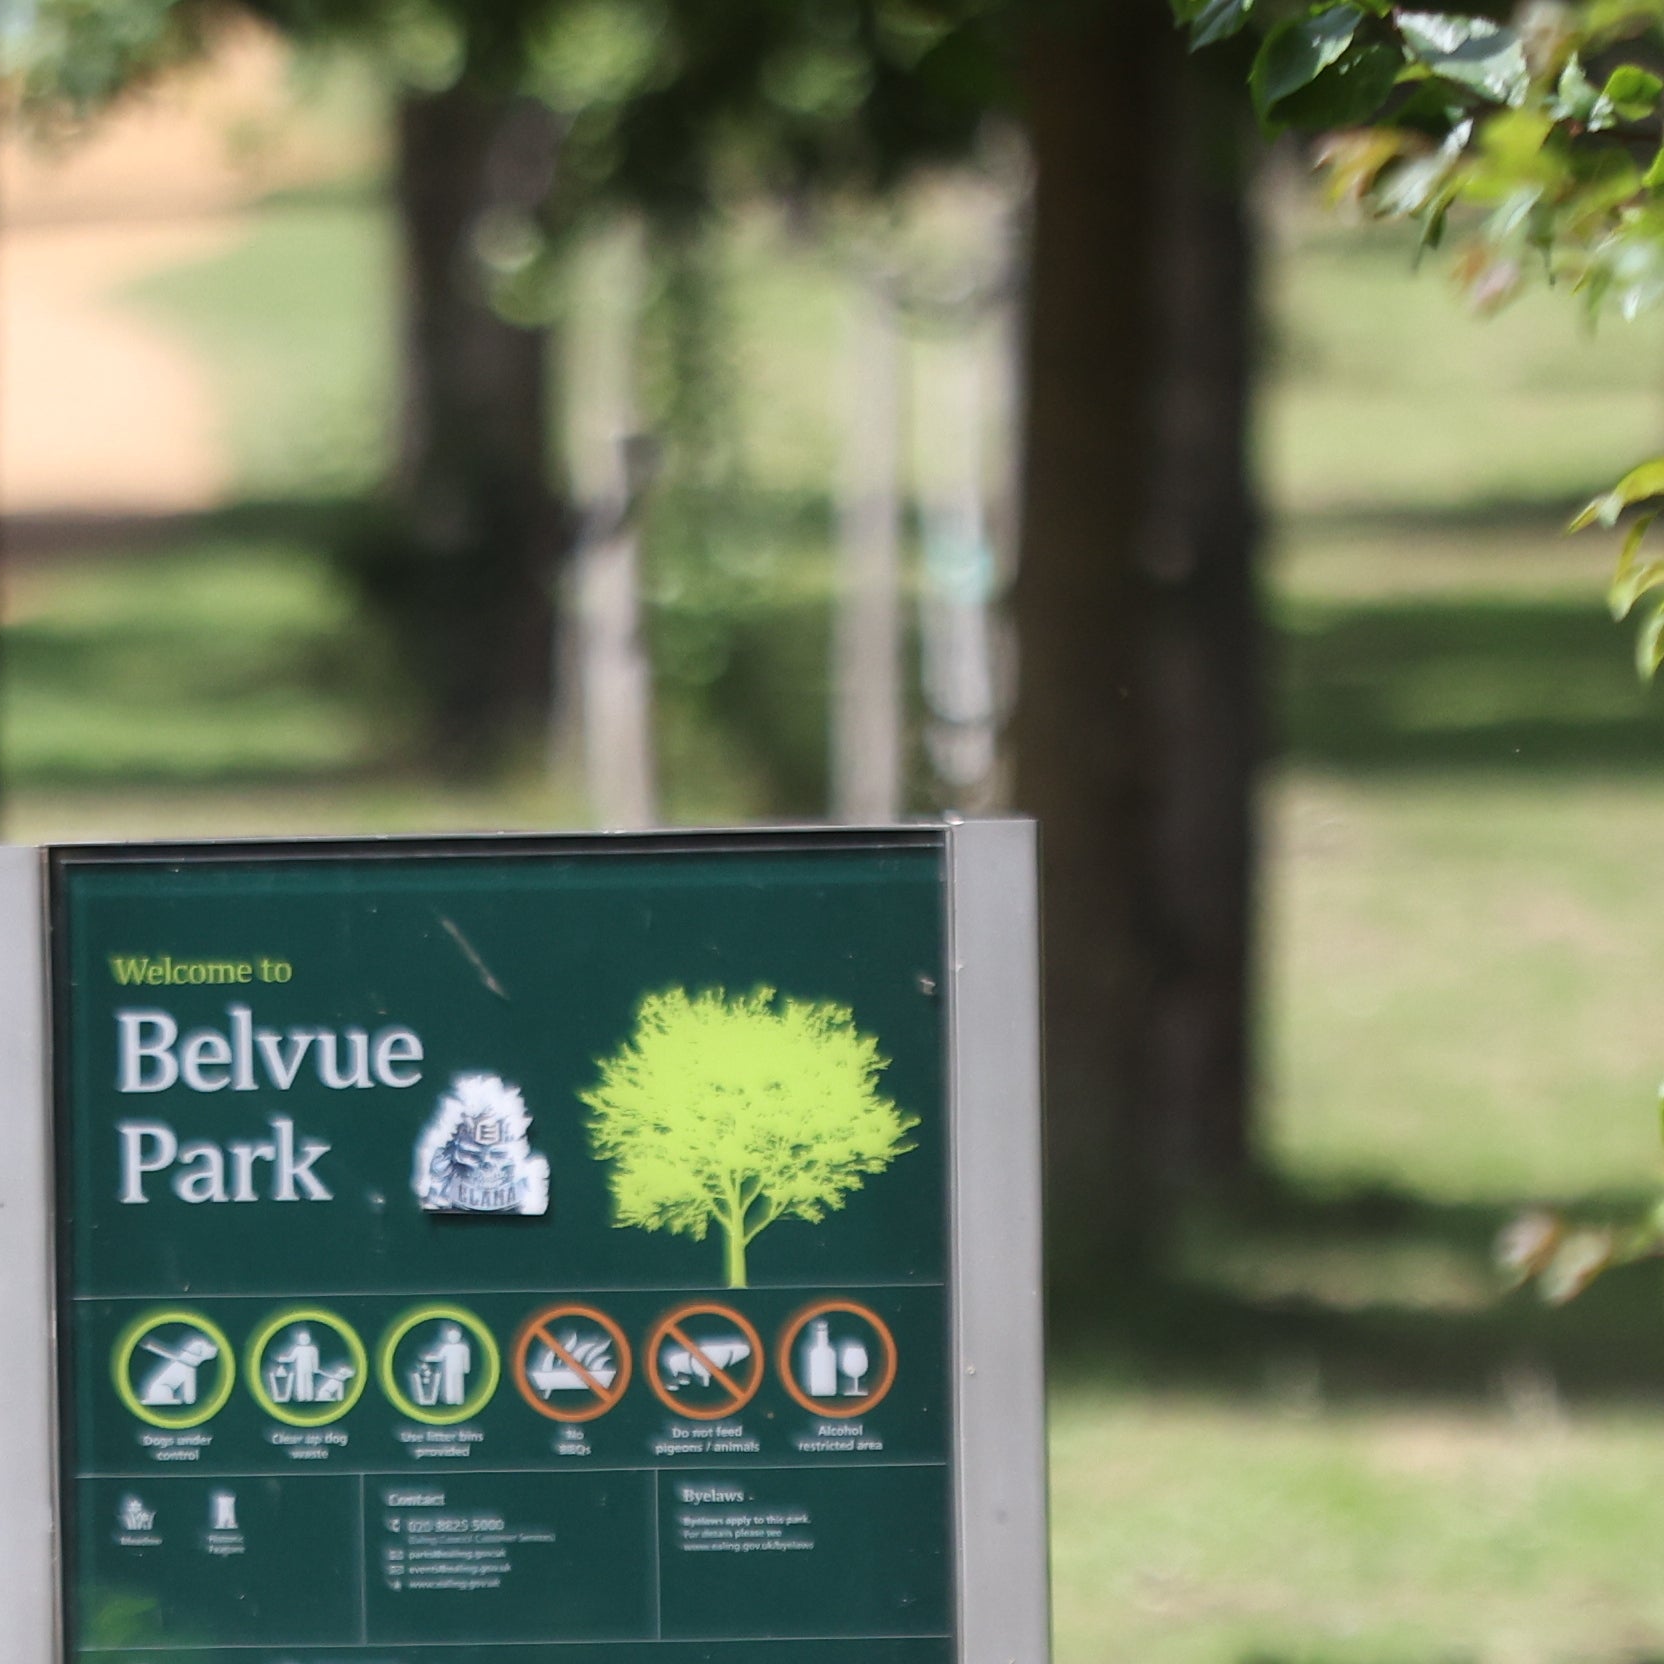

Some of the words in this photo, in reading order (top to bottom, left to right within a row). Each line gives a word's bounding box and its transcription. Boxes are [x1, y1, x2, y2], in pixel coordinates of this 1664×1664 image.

[111, 956, 252, 986] Welcome
[260, 958, 293, 984] to
[116, 1005, 424, 1093] Belvue
[116, 1116, 334, 1204] Park
[399, 1431, 423, 1442] Use
[458, 1430, 484, 1442] bins
[671, 1427, 689, 1439] Do
[692, 1428, 713, 1438] not
[716, 1425, 743, 1438] feed
[817, 1424, 863, 1437] Alcohol
[142, 1434, 174, 1448] Dogs
[176, 1433, 213, 1446] under
[271, 1433, 303, 1446] Clear
[324, 1432, 348, 1447] dog
[798, 1438, 854, 1452] restricted
[856, 1440, 883, 1451] area
[156, 1449, 200, 1462] control
[414, 1444, 471, 1459] provided
[654, 1442, 703, 1456] pigeons
[713, 1440, 761, 1453] animals
[387, 1492, 446, 1507] Contact
[682, 1488, 745, 1506] Byelaws
[726, 1515, 752, 1527] apply
[754, 1514, 764, 1525] to
[766, 1514, 784, 1525] this
[734, 1527, 765, 1540] please
